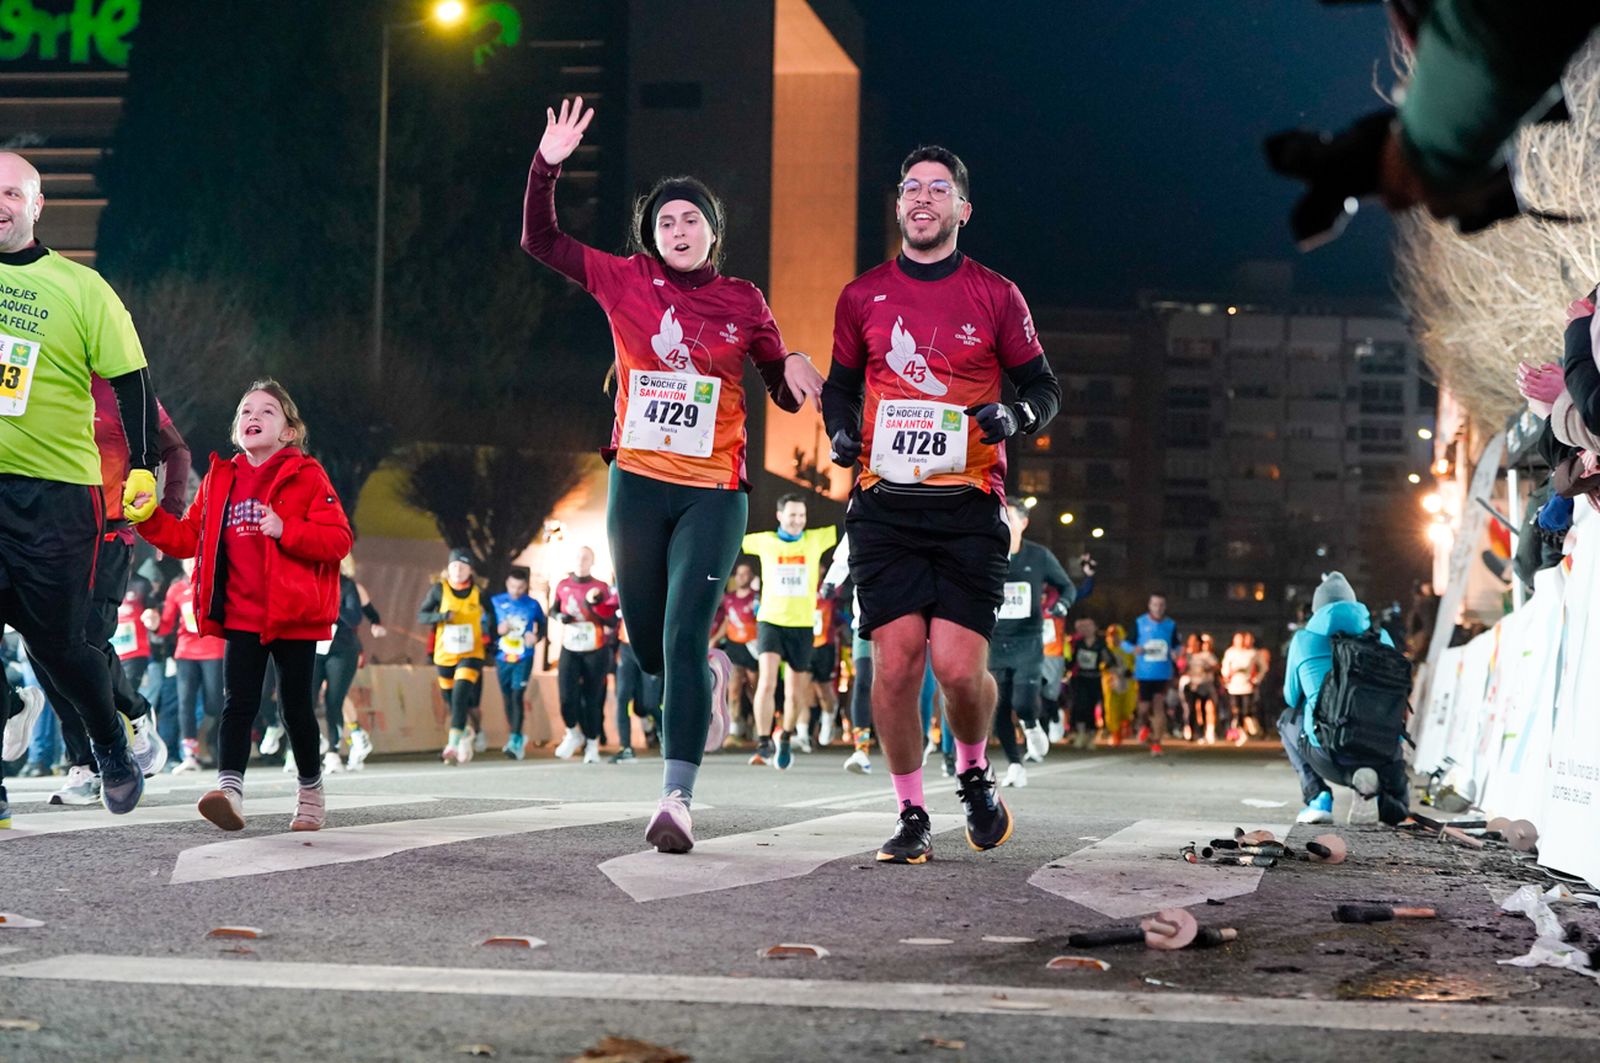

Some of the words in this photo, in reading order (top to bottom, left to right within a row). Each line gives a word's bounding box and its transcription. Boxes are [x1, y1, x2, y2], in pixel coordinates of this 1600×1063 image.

[0, 299, 49, 320] AQUELLO
[665, 349, 689, 370] 43
[903, 360, 927, 384] 43
[639, 388, 656, 397] SAN
[657, 389, 687, 401] ANTÓN
[651, 381, 675, 389] NOCHE
[677, 383, 687, 391] DE
[644, 400, 698, 427] 4729
[885, 419, 902, 429] SAN
[903, 418, 934, 429] ANTÓN
[895, 409, 922, 418] NOCHE
[923, 410, 935, 419] DE
[892, 430, 947, 456] 4728
